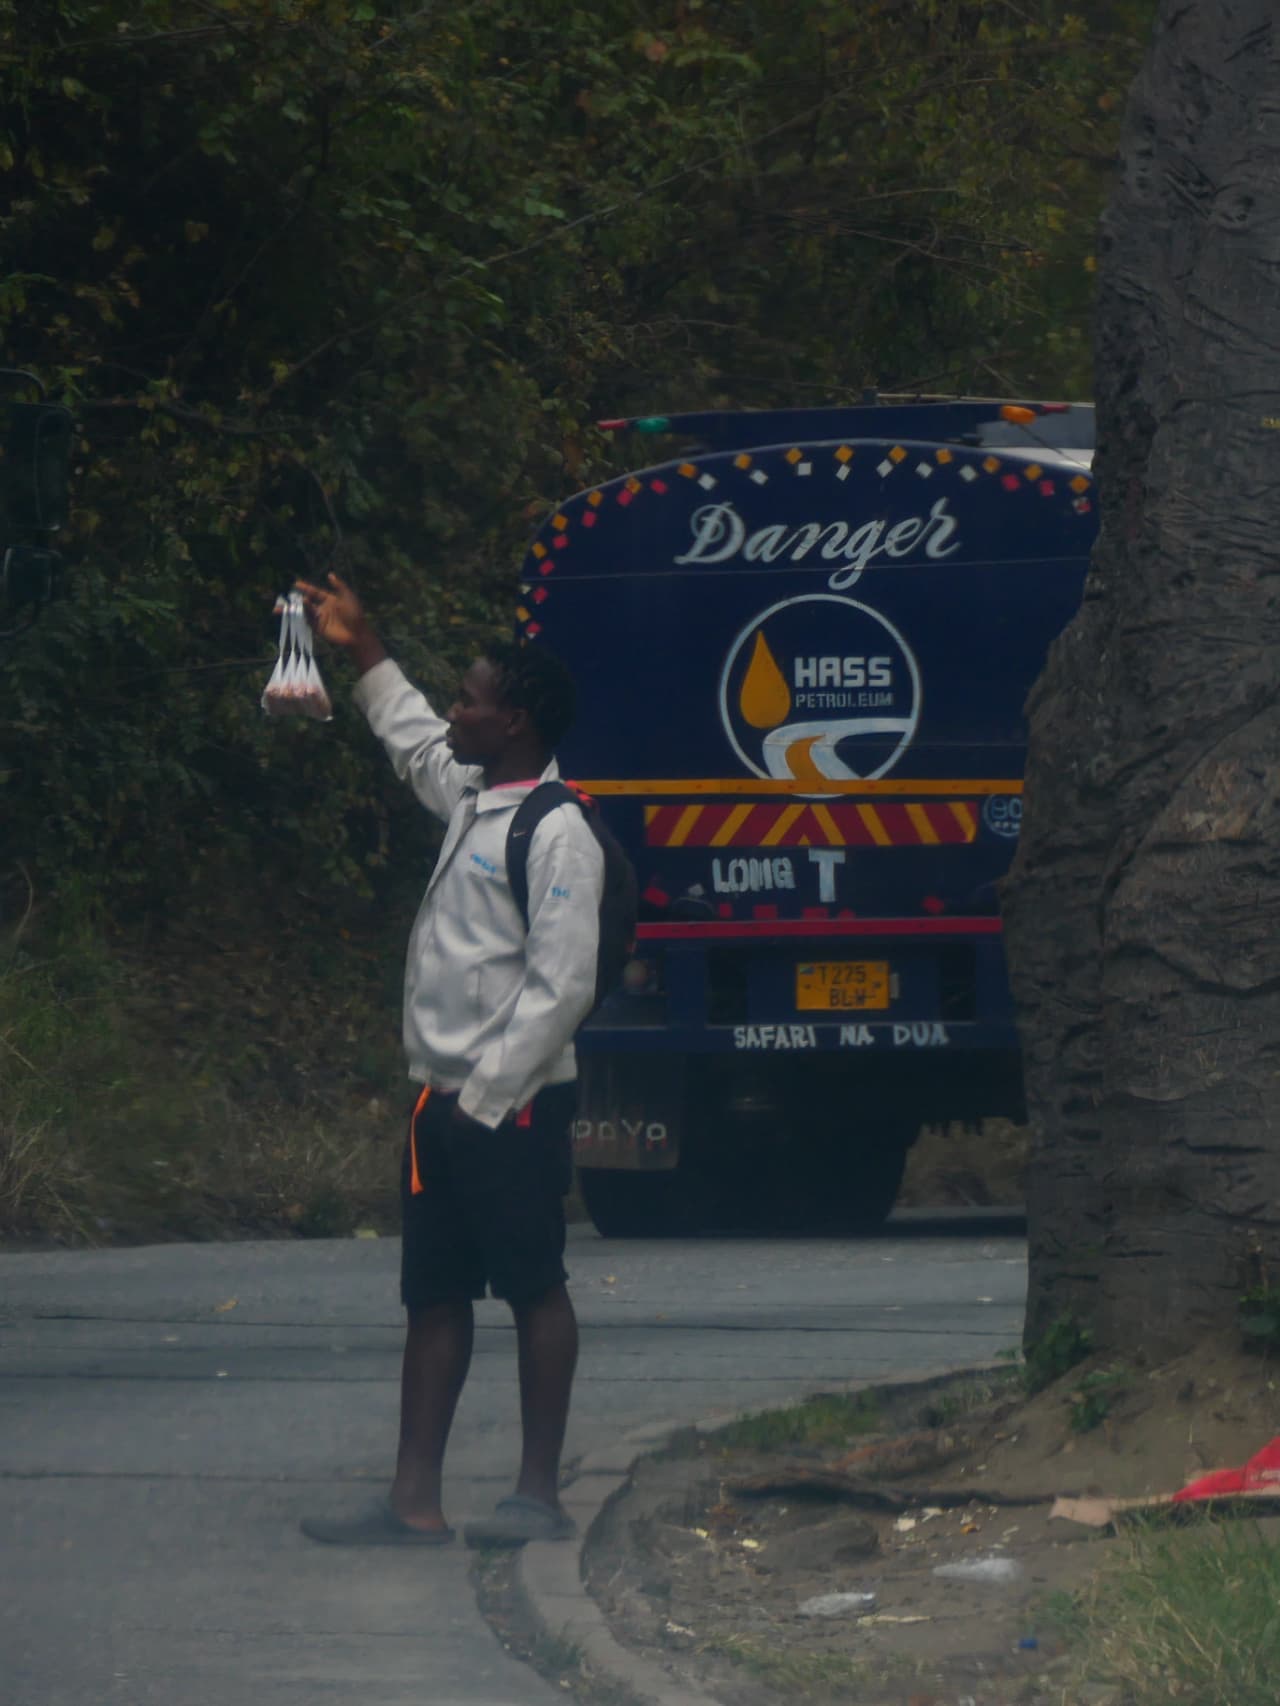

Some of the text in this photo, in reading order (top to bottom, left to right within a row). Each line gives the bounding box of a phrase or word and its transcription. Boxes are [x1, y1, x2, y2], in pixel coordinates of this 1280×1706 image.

[672, 496, 962, 591] Danger
[793, 656, 892, 688] HASS
[794, 691, 895, 709] PETROLEUM
[808, 848, 846, 903] T
[733, 1022, 950, 1049] SAFARI NA DUA
